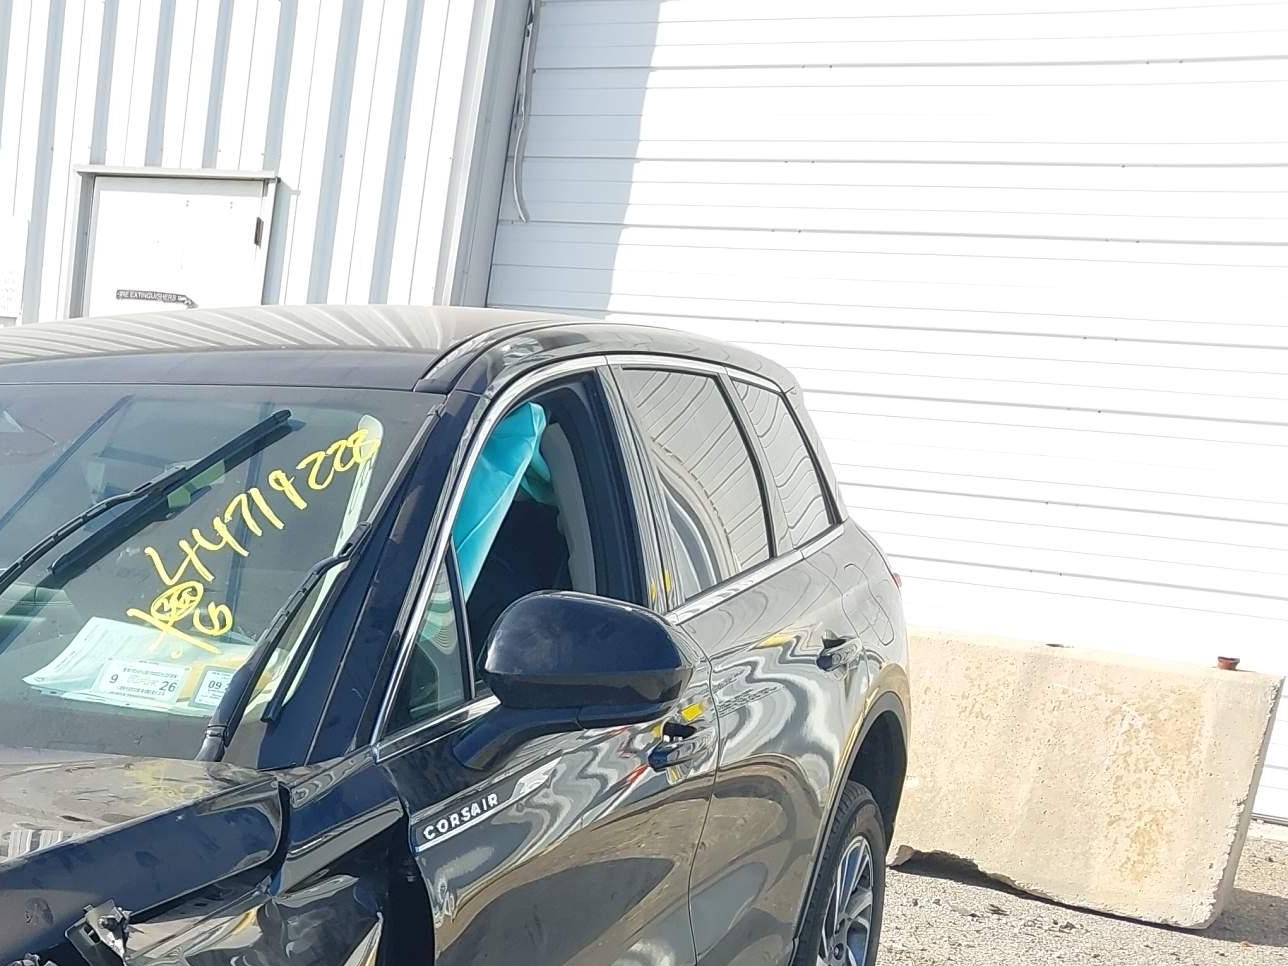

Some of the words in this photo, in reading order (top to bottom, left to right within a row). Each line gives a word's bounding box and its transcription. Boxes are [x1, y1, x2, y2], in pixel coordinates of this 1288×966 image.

[144, 428, 381, 586] 44719228
[109, 673, 119, 684] 9
[159, 680, 178, 692] 26
[208, 680, 222, 690] 09
[423, 793, 499, 840] CORSAIR
